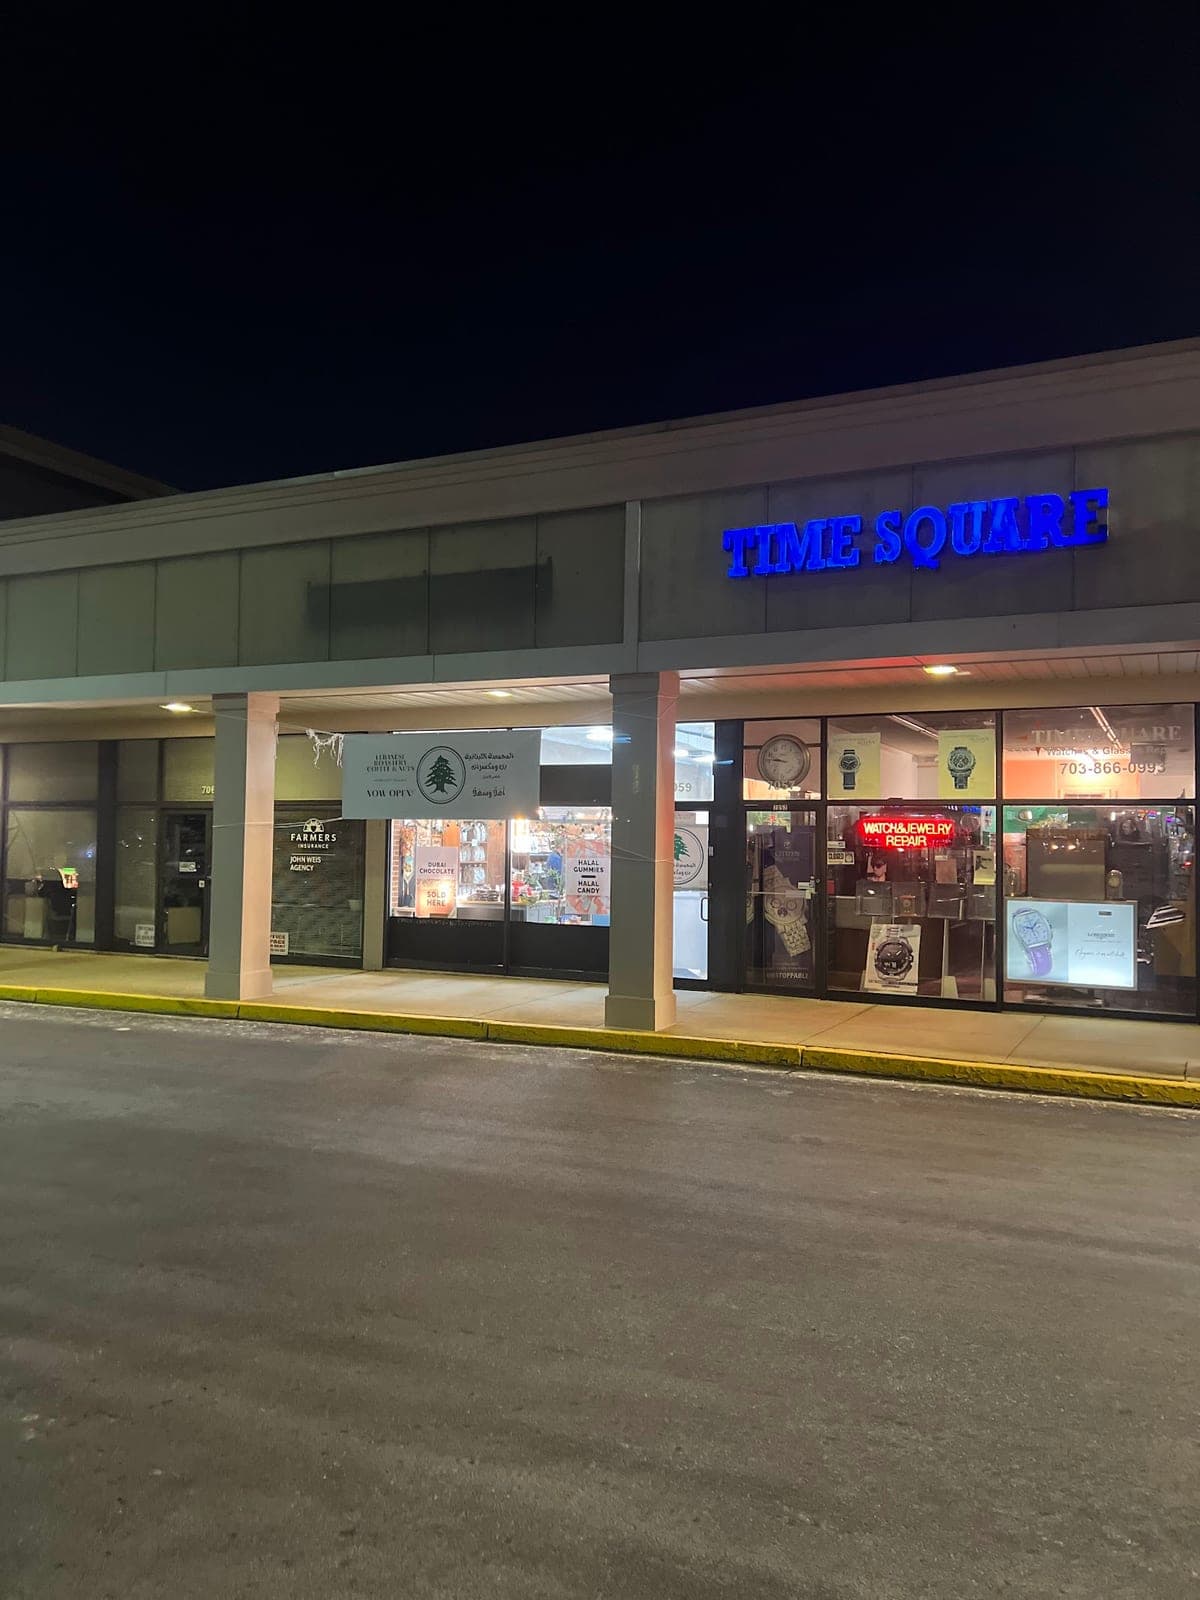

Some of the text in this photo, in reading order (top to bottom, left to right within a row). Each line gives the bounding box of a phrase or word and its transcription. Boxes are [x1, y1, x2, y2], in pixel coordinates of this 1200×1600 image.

[722, 488, 1109, 578] TIME SQUARE
[1059, 762, 1166, 775] 703-866-0993
[366, 789, 413, 797] NOW OPEN
[290, 833, 337, 842] FARMERS
[885, 835, 927, 847] REPAIR
[290, 856, 306, 864] JOHN
